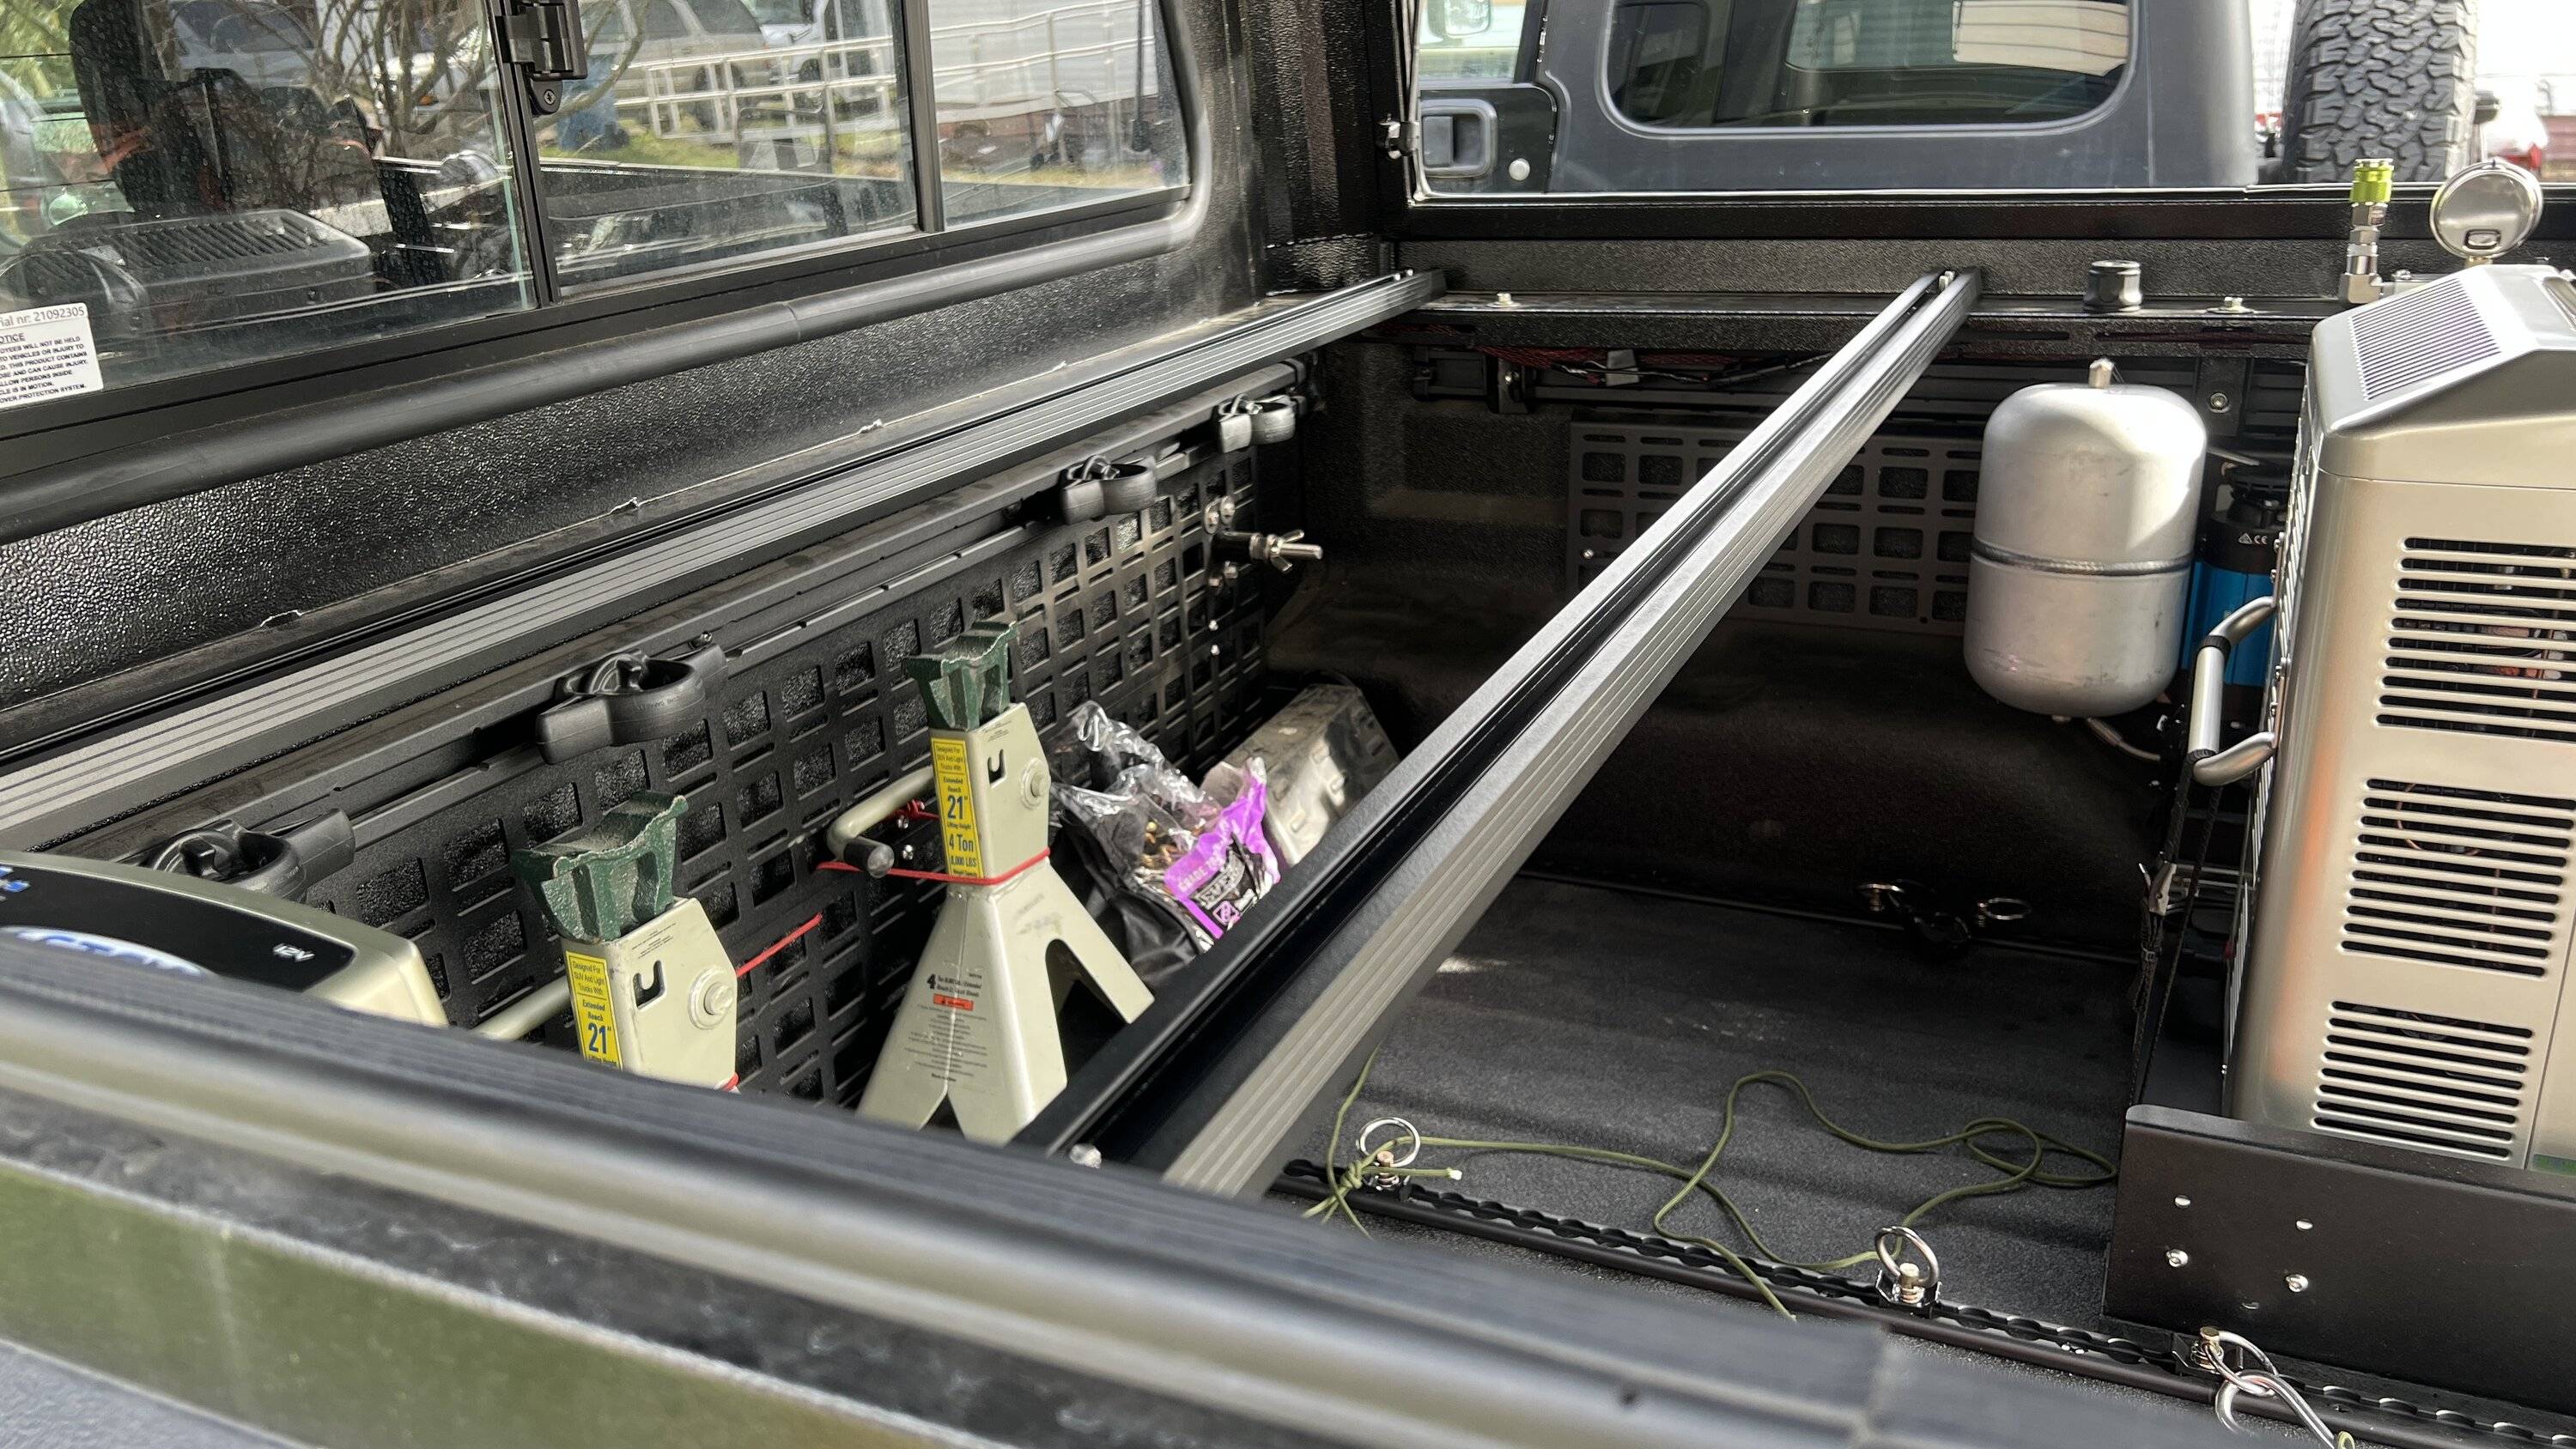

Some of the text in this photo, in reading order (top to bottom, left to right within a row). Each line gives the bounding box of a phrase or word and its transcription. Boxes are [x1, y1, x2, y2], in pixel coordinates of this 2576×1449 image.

[16, 315, 31, 324] nr.
[33, 306, 84, 321] 21092305
[9, 350, 40, 361] VEHICLES
[52, 345, 74, 354] INJURY
[25, 356, 54, 367] PRODUCT
[57, 351, 87, 361] CONTAINS
[42, 363, 64, 372] CAUSE
[21, 373, 51, 383] PERSONS
[19, 388, 59, 399] PROTECTION
[949, 834, 974, 852] 4 Ton
[273, 943, 315, 962] 12V
[927, 973, 937, 990] 4
[583, 999, 605, 1011] Extended
